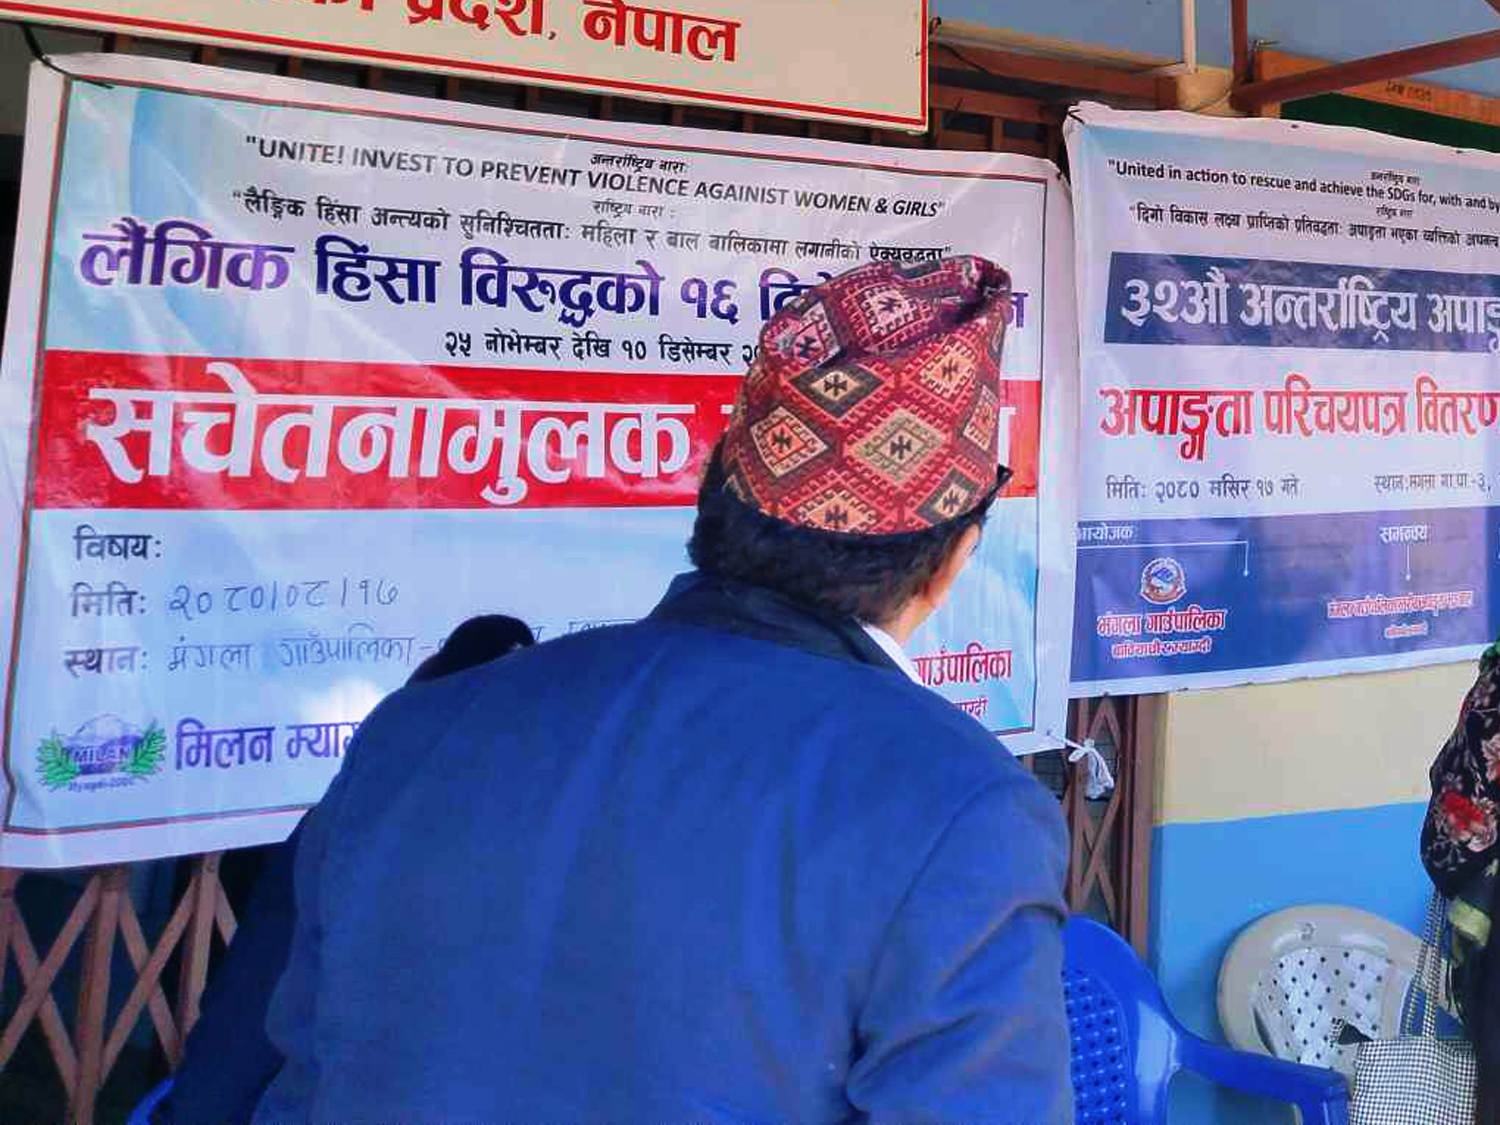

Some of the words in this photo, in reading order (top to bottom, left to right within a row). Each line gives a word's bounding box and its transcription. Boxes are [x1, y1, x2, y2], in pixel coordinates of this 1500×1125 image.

[352, 146, 436, 175] INVEST
[443, 156, 474, 178] TO
[481, 160, 582, 187] PREVENT
[587, 170, 690, 197] VIOLENCE
[693, 181, 790, 205] AGAINIST
[794, 189, 871, 213] WOMEN
[874, 197, 888, 214] &
[1168, 164, 1182, 179] in
[1185, 169, 1229, 185] action
[1232, 172, 1247, 186] to
[1250, 175, 1291, 190] rescue
[1294, 178, 1317, 193] and
[1320, 181, 1363, 197] achieve
[1366, 183, 1385, 199] the
[1387, 186, 1415, 203] SDGs
[1418, 190, 1436, 206] for,
[1439, 192, 1462, 206] with
[1465, 196, 1486, 210] and
[1488, 198, 1500, 214] by
[316, 196, 361, 225] हिंसा
[580, 219, 637, 248] महिला
[644, 228, 659, 251] र
[667, 230, 701, 251] बाल
[709, 229, 789, 257] बालिकामा
[795, 238, 861, 261] लगानीको
[1169, 204, 1208, 226] विकास
[314, 235, 441, 305] हिंसा
[680, 277, 739, 325] १६
[445, 331, 472, 357] २५
[484, 328, 564, 360] नोभेम्बर
[571, 330, 612, 360] देखि
[621, 339, 648, 361] १०
[658, 332, 735, 365] डिसेम्बर
[1263, 374, 1408, 438] परिचयपत्र
[84, 362, 695, 504] सचेतनामुलक
[1154, 479, 1200, 503] २०८०
[1256, 479, 1274, 498] १७
[168, 635, 254, 671] मंगला
[175, 717, 275, 770] मिलन
